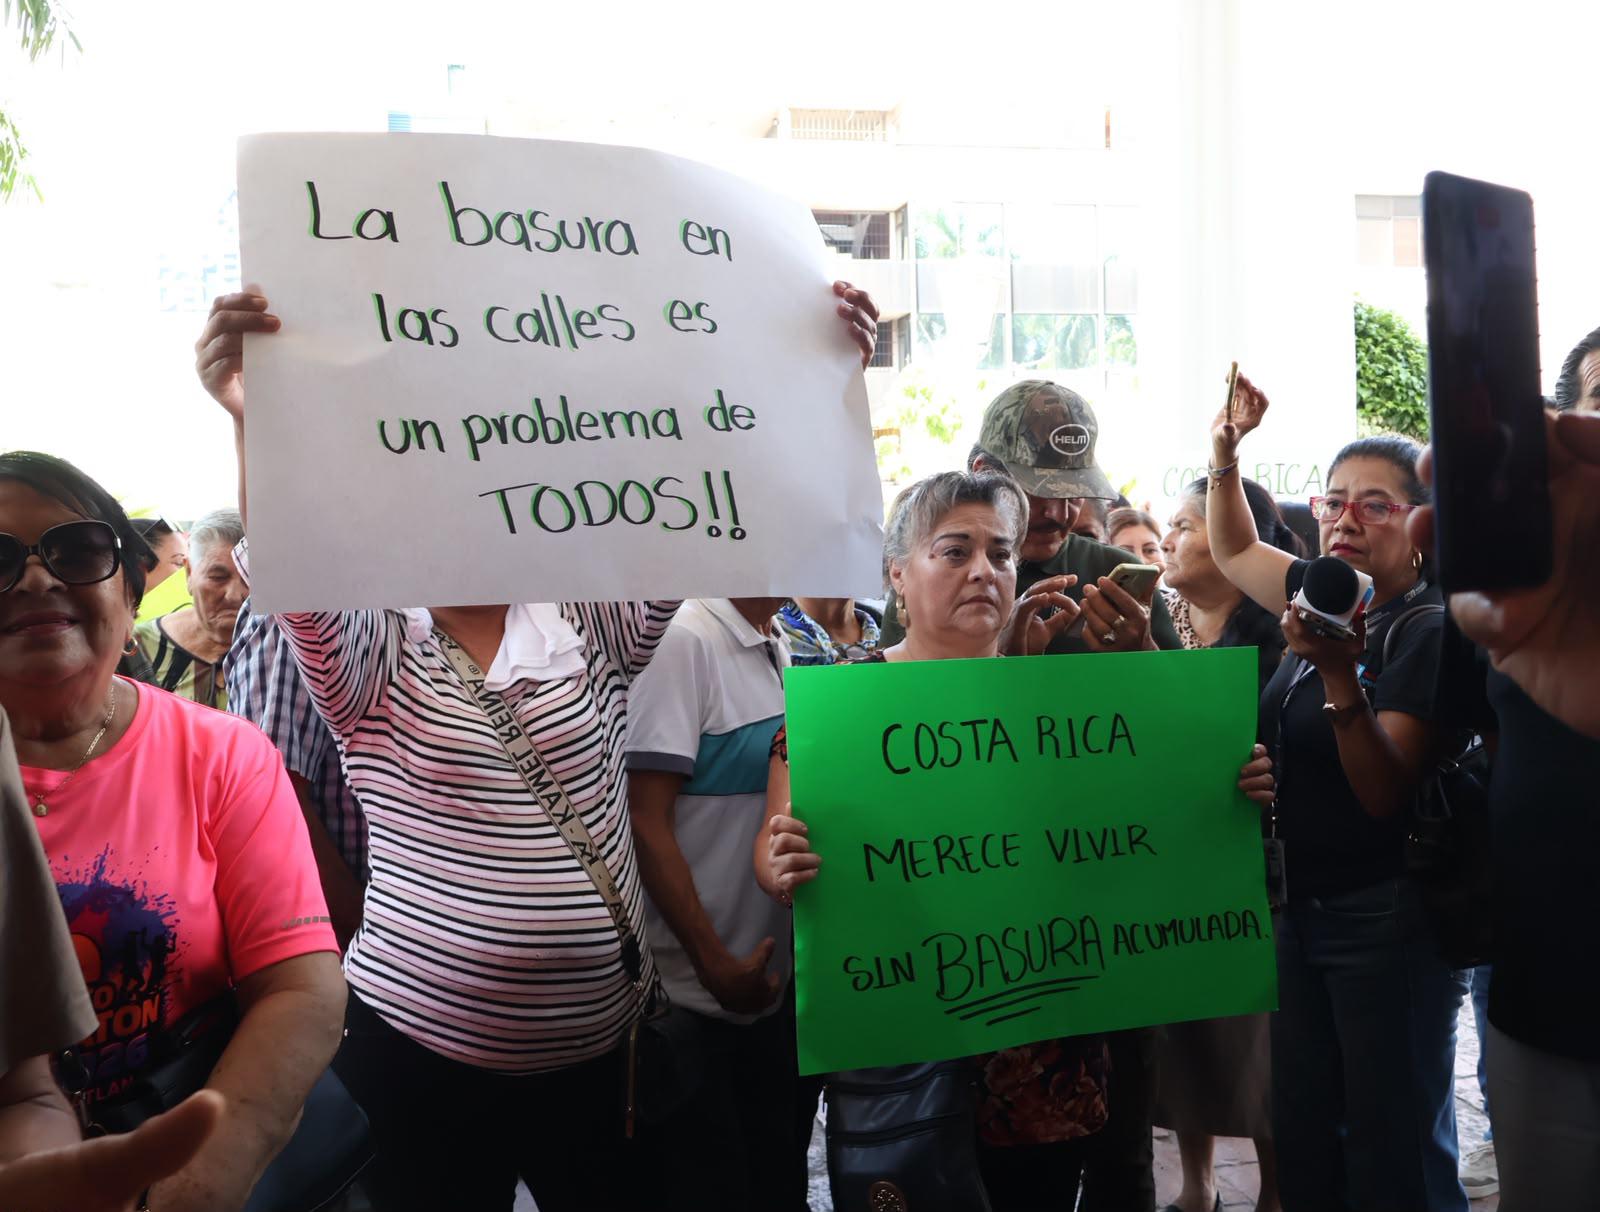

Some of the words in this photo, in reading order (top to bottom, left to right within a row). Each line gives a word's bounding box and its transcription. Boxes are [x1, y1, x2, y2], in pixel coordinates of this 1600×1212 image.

[306, 181, 399, 243] La
[438, 181, 639, 255] basura
[680, 219, 732, 261] en
[372, 293, 459, 348] las
[483, 291, 635, 350] calles
[663, 300, 717, 334] es
[377, 418, 445, 454] un
[462, 395, 683, 461] problema
[704, 389, 756, 432] de
[1055, 434, 1086, 445] HELM
[478, 470, 746, 540] TODOS!!
[882, 718, 1018, 774] COSTA
[1037, 713, 1136, 759] RICA
[863, 834, 1020, 882] MERECE
[1045, 825, 1156, 863] VIVIR
[843, 952, 915, 991] SIN
[922, 915, 1104, 1003] BASURA
[1114, 909, 1270, 955] ACUMULADA.
